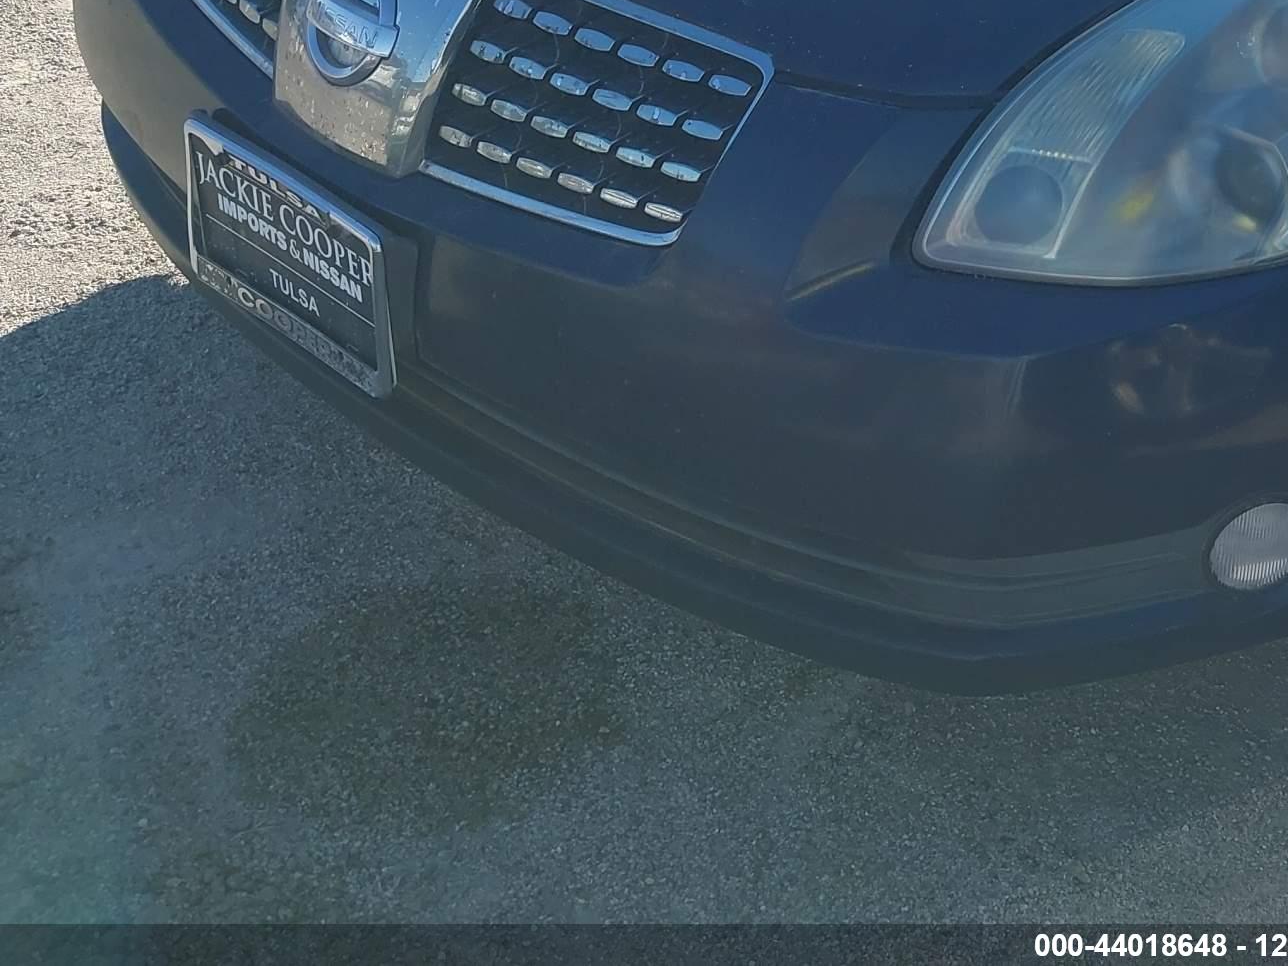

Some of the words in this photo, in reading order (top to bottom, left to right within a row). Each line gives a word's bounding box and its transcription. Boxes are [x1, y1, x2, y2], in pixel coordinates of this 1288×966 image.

[196, 151, 274, 222] JACKIE
[280, 204, 373, 287] COOPER
[218, 193, 288, 251] IMPORTS
[290, 239, 303, 263] &
[303, 247, 363, 304] NISSAN
[269, 268, 320, 317] TULSA
